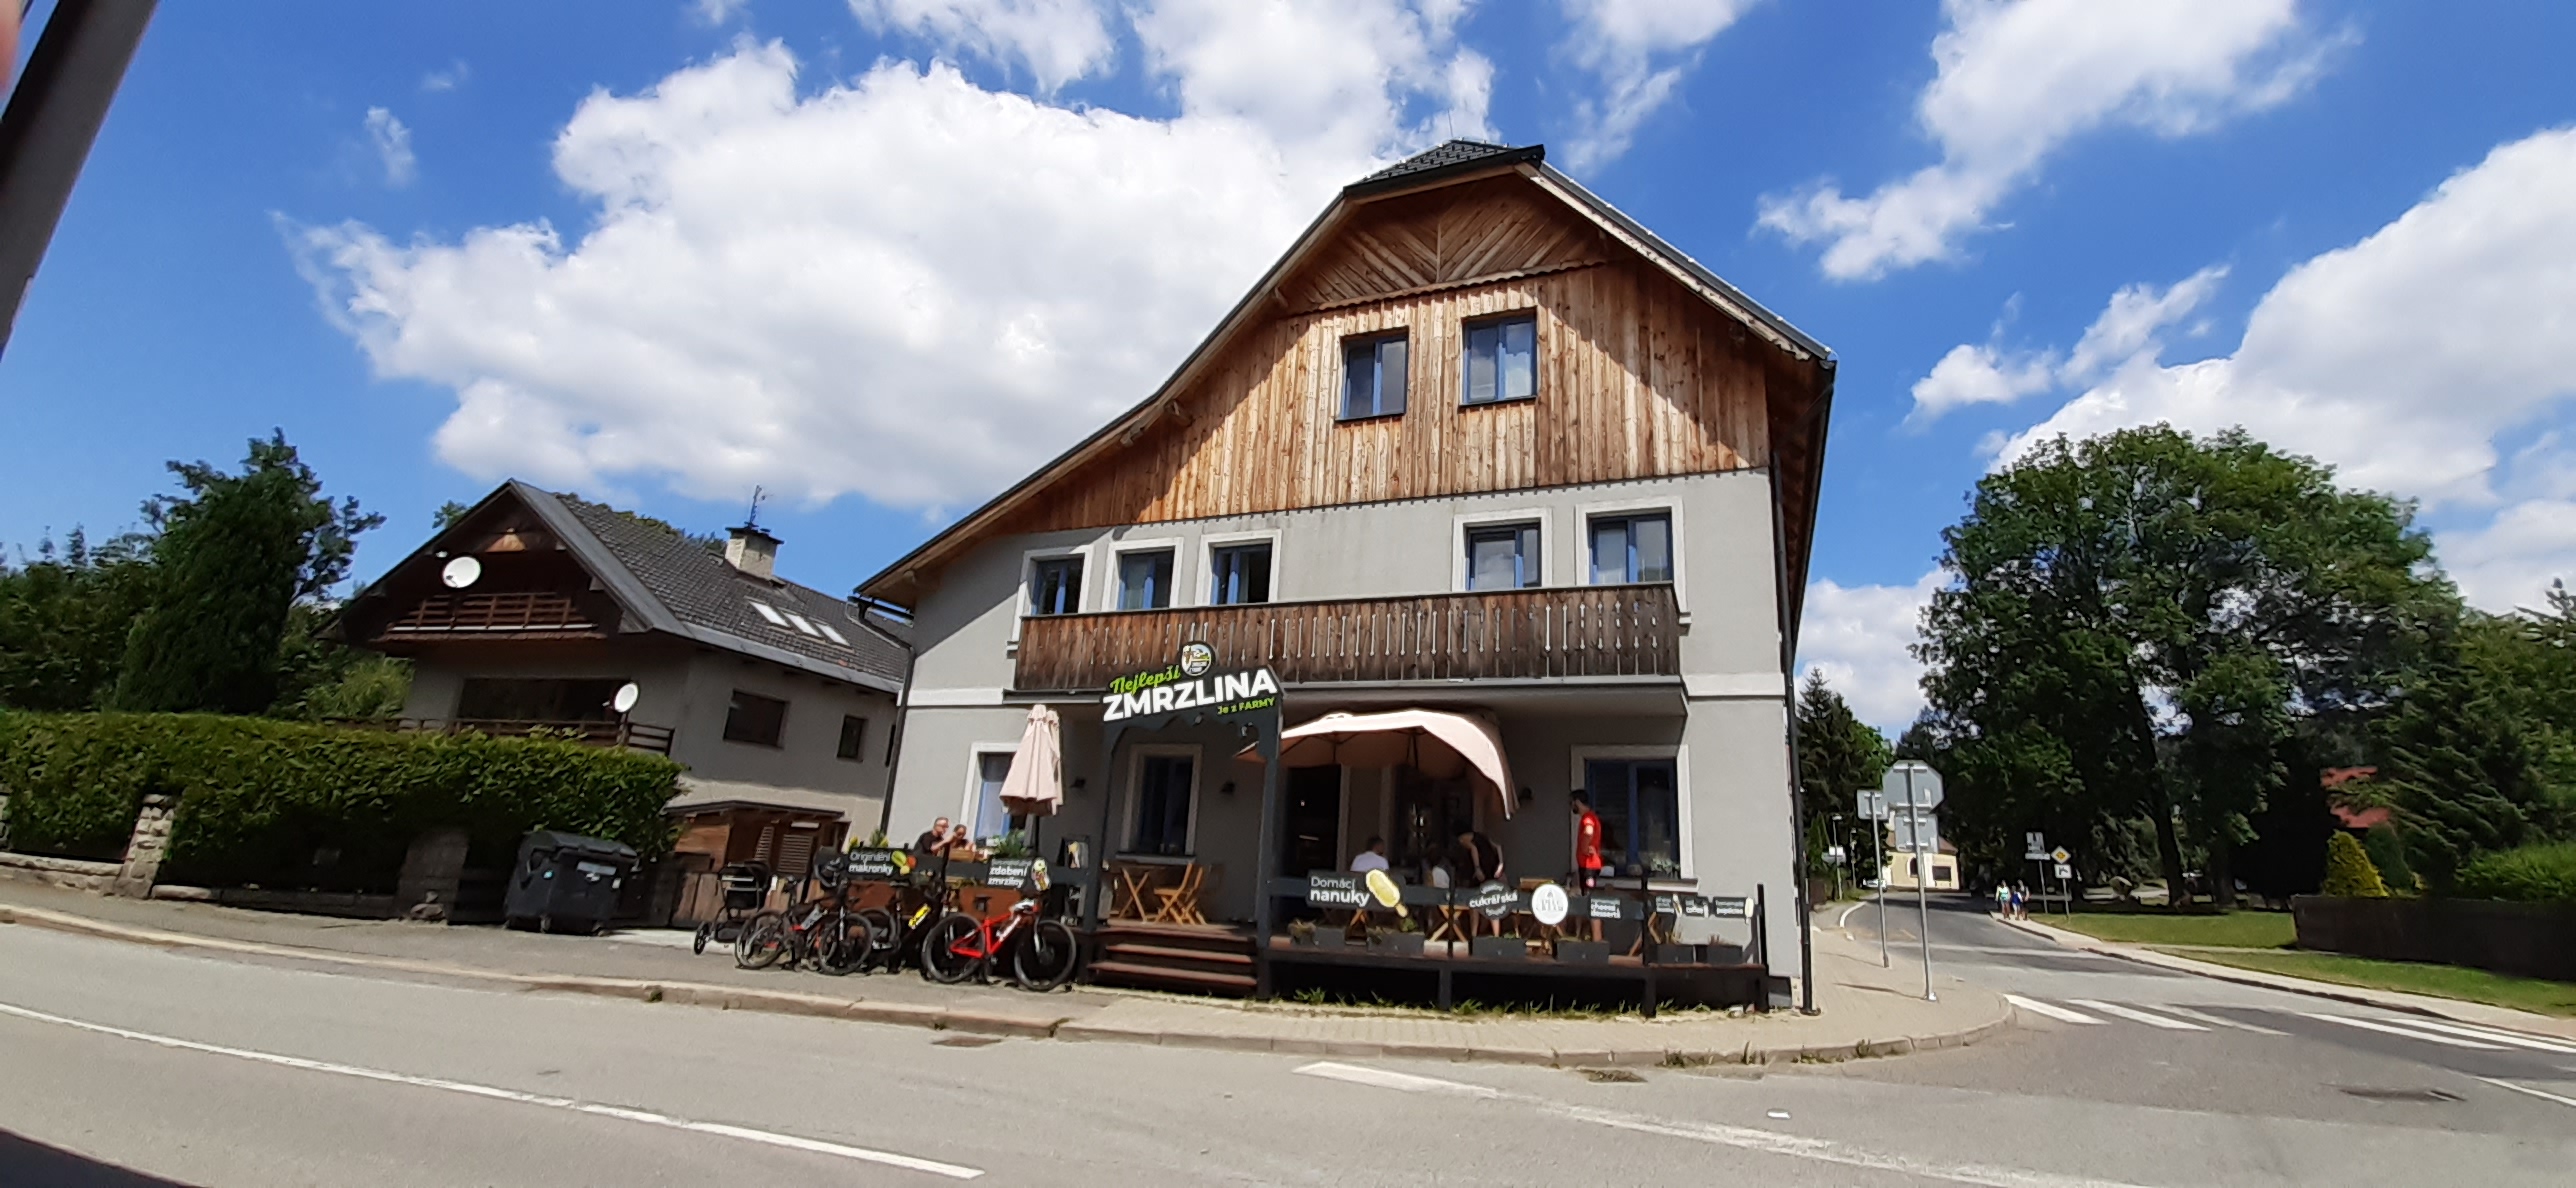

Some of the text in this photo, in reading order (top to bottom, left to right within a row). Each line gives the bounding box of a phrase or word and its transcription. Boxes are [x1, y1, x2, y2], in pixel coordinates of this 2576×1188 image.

[1109, 664, 1181, 696] Nejlepší
[1102, 668, 1278, 722] ZMRZLINA
[1217, 705, 1229, 715] Je
[1238, 697, 1276, 712] FARMY
[1311, 875, 1355, 890] Domácí
[1310, 888, 1370, 907] nanuky
